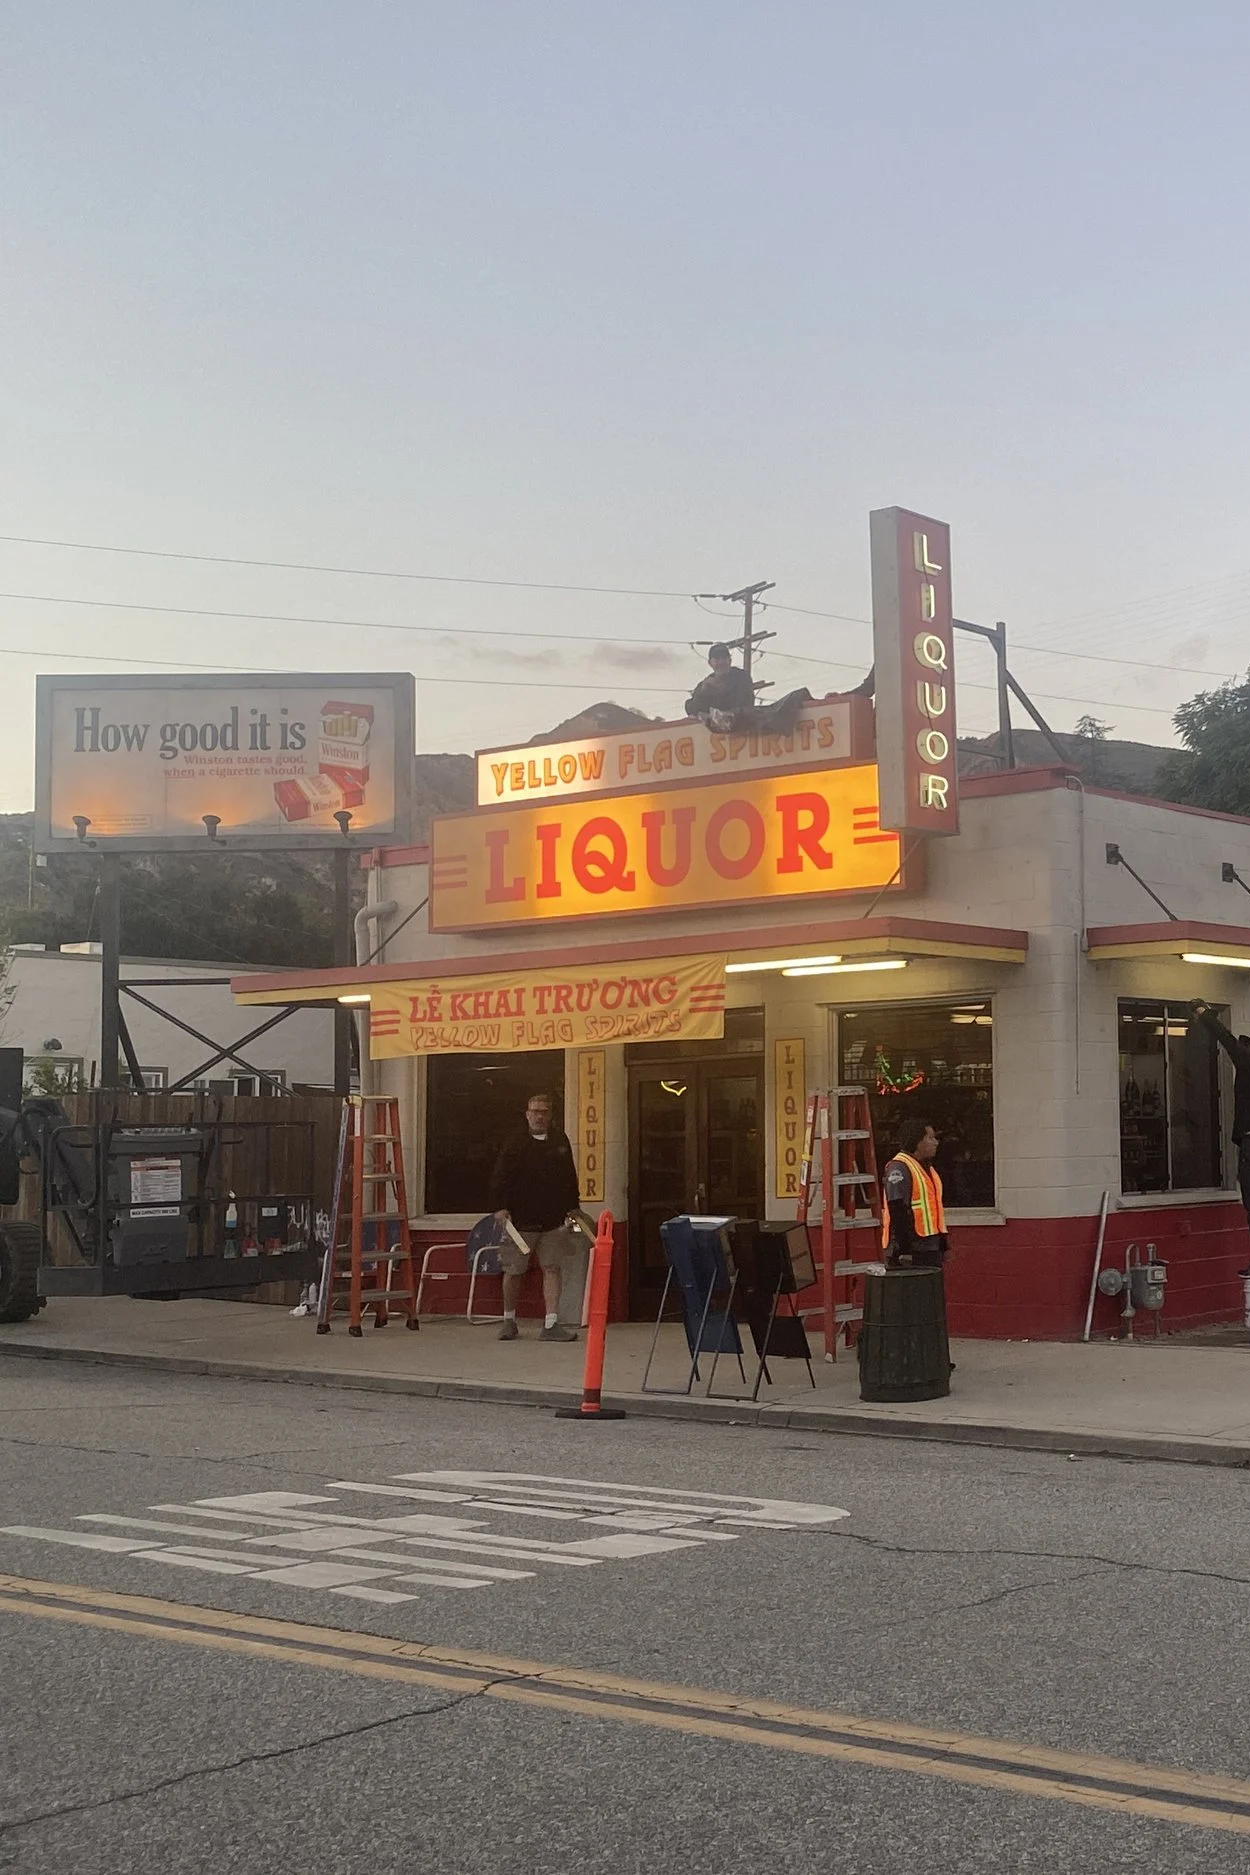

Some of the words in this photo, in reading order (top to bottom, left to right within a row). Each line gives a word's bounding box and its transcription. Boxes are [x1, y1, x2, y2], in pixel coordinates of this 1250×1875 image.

[912, 531, 949, 811] LIQUOR
[74, 707, 150, 752] How
[159, 706, 239, 760] good
[249, 708, 271, 751] it
[279, 708, 306, 750] is
[184, 755, 233, 765] Winston
[237, 755, 273, 764] tastes
[321, 743, 359, 761] Winston
[491, 749, 605, 796] YELLOW
[618, 736, 696, 779] FLAG
[710, 716, 835, 763] SPIRITS
[164, 768, 195, 777] when
[198, 769, 206, 777] a
[208, 766, 261, 779] cigarette
[485, 792, 833, 904] LIQUOR
[409, 1023, 501, 1051] YELLOW
[511, 1018, 574, 1047] FLAG
[586, 1009, 682, 1041] SPIRITS
[449, 987, 526, 1021] KHAI
[586, 1057, 598, 1196] LIQUOR
[784, 1045, 798, 1192] LIQUOR
